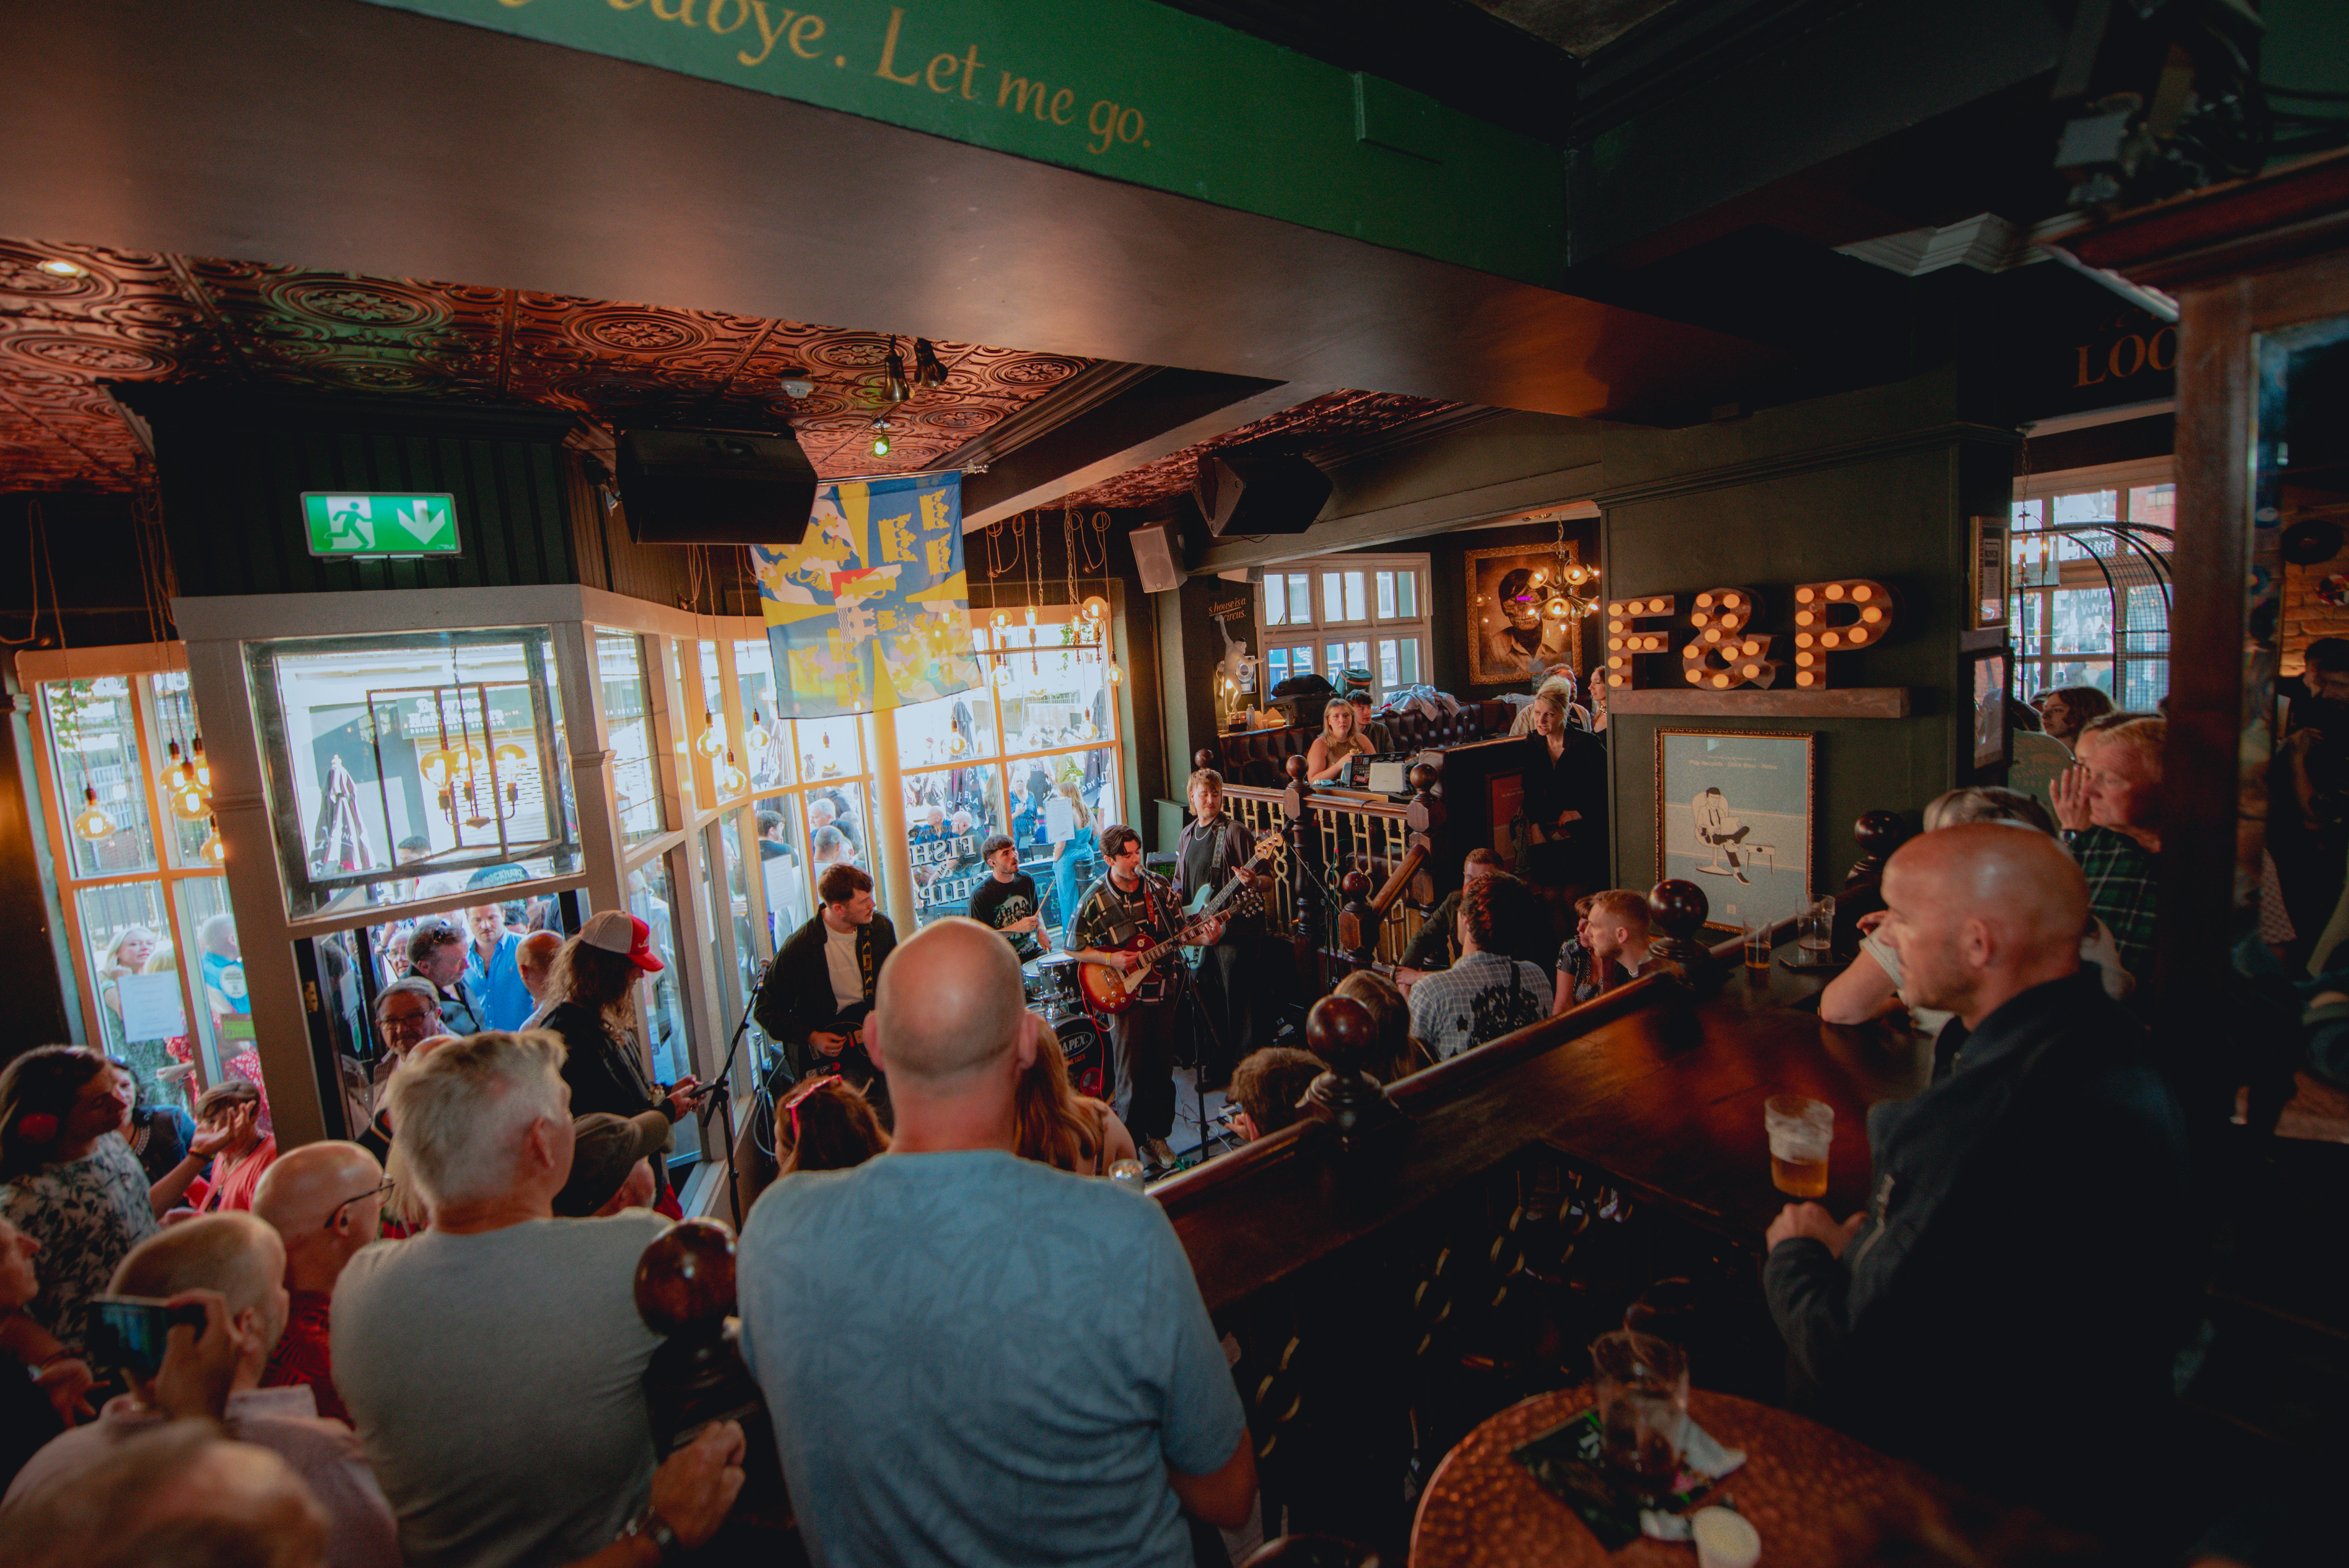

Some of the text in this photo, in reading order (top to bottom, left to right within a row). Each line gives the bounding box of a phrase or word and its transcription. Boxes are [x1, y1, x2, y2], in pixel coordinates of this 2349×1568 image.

[874, 6, 987, 100] Let
[996, 70, 1074, 125] me
[1087, 99, 1151, 155] go.
[1214, 601, 1234, 613] house
[1235, 598, 1240, 607] is
[1223, 610, 1247, 622] circus.
[1609, 579, 1894, 691] F&P
[410, 726, 439, 734] BESPOK
[471, 721, 505, 729] STYISTS
[1059, 1034, 1086, 1055] APEX
